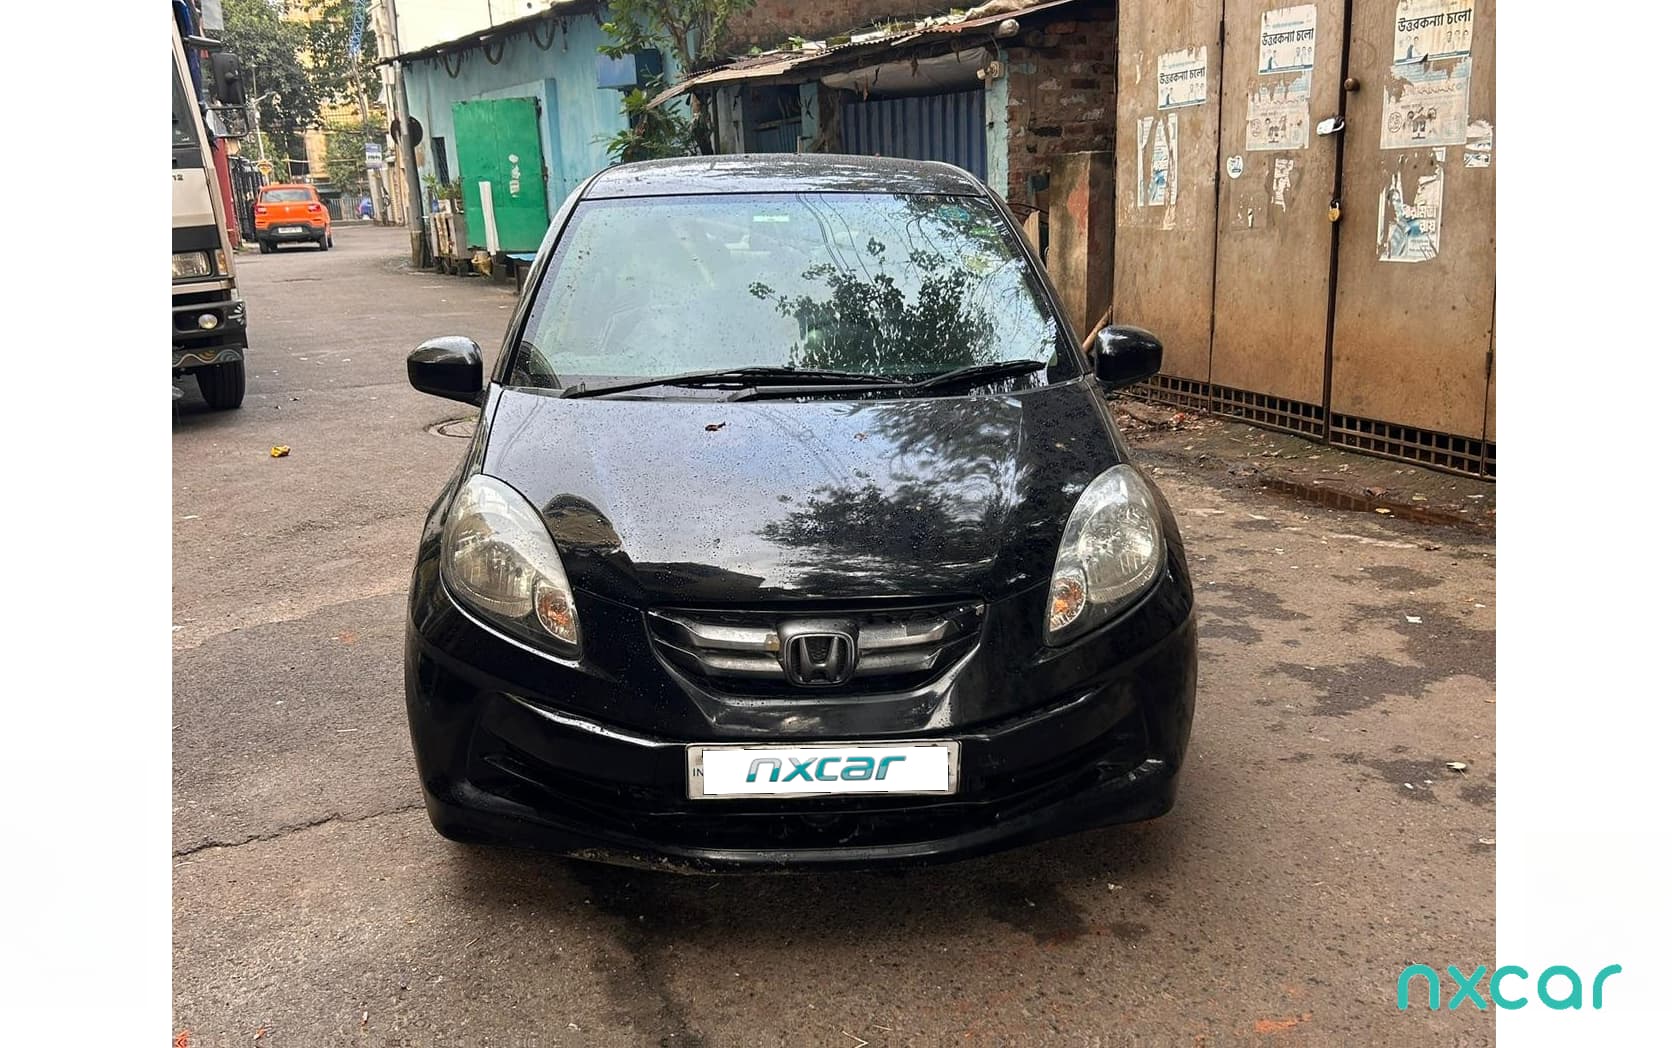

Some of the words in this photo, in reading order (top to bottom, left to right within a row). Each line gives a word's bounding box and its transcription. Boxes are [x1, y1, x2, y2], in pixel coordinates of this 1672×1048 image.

[1397, 13, 1445, 32] উত্তরকন্যা
[1446, 8, 1472, 25] চলো
[1296, 27, 1314, 41] চলো
[1189, 66, 1206, 80] চলো
